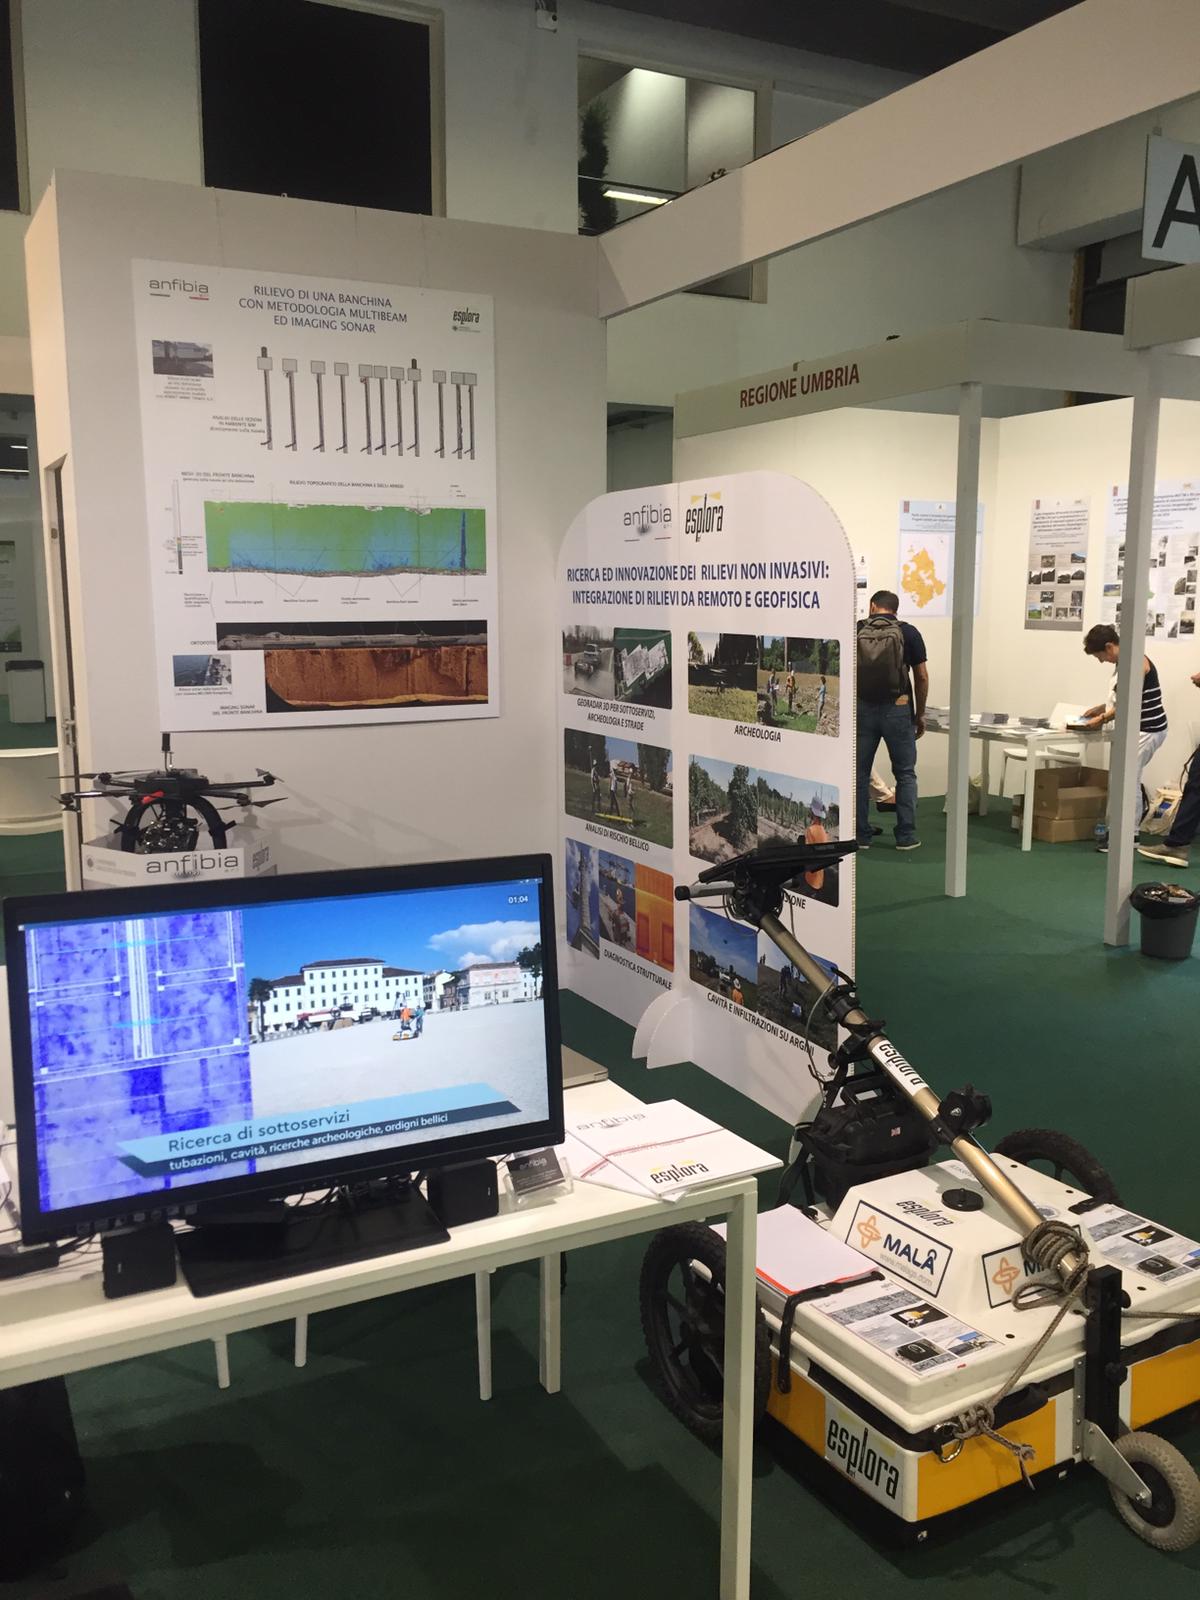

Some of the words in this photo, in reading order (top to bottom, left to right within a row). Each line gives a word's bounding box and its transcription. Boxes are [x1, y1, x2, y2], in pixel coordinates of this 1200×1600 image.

[149, 278, 209, 294] anfibia
[254, 285, 295, 300] RILIEVO
[298, 289, 310, 301] DI
[313, 291, 336, 304] UNA
[338, 293, 392, 308] BANCHINA
[239, 298, 264, 311] CON
[267, 302, 347, 318] METODOLOGIA
[349, 308, 408, 324] MULTIBEAM
[453, 307, 481, 326] esplora
[274, 315, 288, 326] ED
[291, 317, 337, 331] IMAGING
[340, 321, 376, 334] SONAR
[740, 376, 797, 409] REGIONE
[801, 363, 860, 396] UMBRIA
[623, 503, 672, 528] anfibia
[685, 493, 724, 543] esplora
[567, 566, 600, 583] RICERCA
[602, 566, 614, 582] ED
[615, 564, 678, 582] INNOVAZIONE
[680, 564, 697, 581] DEI
[701, 563, 738, 581] RILIEVI
[740, 562, 766, 580] NON
[769, 560, 830, 580] INVASIVI:
[572, 590, 634, 606] INTEGRAZIONE
[635, 590, 645, 606] DI
[646, 590, 679, 606] RILIEVI
[680, 590, 696, 607] DA
[697, 590, 742, 608] REMOTO
[745, 590, 752, 608] E
[754, 590, 821, 609] GEOFISICA
[577, 698, 603, 710] GEORADAR
[603, 701, 610, 711] 3D
[610, 702, 619, 712] PER
[619, 704, 656, 720] SOTTOSERVIZI,
[587, 712, 620, 727] ARCHEOLOGIA
[621, 718, 625, 728] E
[625, 719, 644, 731] STRADE
[734, 725, 782, 743] ARCHEOLOGIA
[585, 823, 604, 836] ANALISI
[603, 828, 609, 838] DI
[609, 829, 629, 845] RISCHIO
[629, 836, 649, 852] BELLICO
[146, 852, 239, 874] anfibia
[508, 895, 528, 904] 01:04
[603, 949, 636, 972] DIAGNOSTICA
[636, 965, 673, 990] STRUTTURALE
[707, 992, 728, 1012] CAVITÀ
[728, 1005, 733, 1013] E
[733, 1005, 779, 1037] INFILTRAZIONI
[779, 1029, 790, 1042] SU
[168, 1132, 232, 1153] Ricerca
[237, 1125, 253, 1140] di
[258, 1109, 350, 1137] sottoservizi
[169, 1153, 228, 1171] tubazioni,
[230, 1144, 268, 1160] cavità,
[269, 1138, 311, 1153] ricerche
[311, 1125, 384, 1146] archeologiche,
[384, 1119, 420, 1134] ordigni
[420, 1113, 449, 1127] bellici
[650, 1162, 710, 1184] esplora
[896, 1200, 954, 1228] esplora
[827, 1419, 900, 1500] esplora
